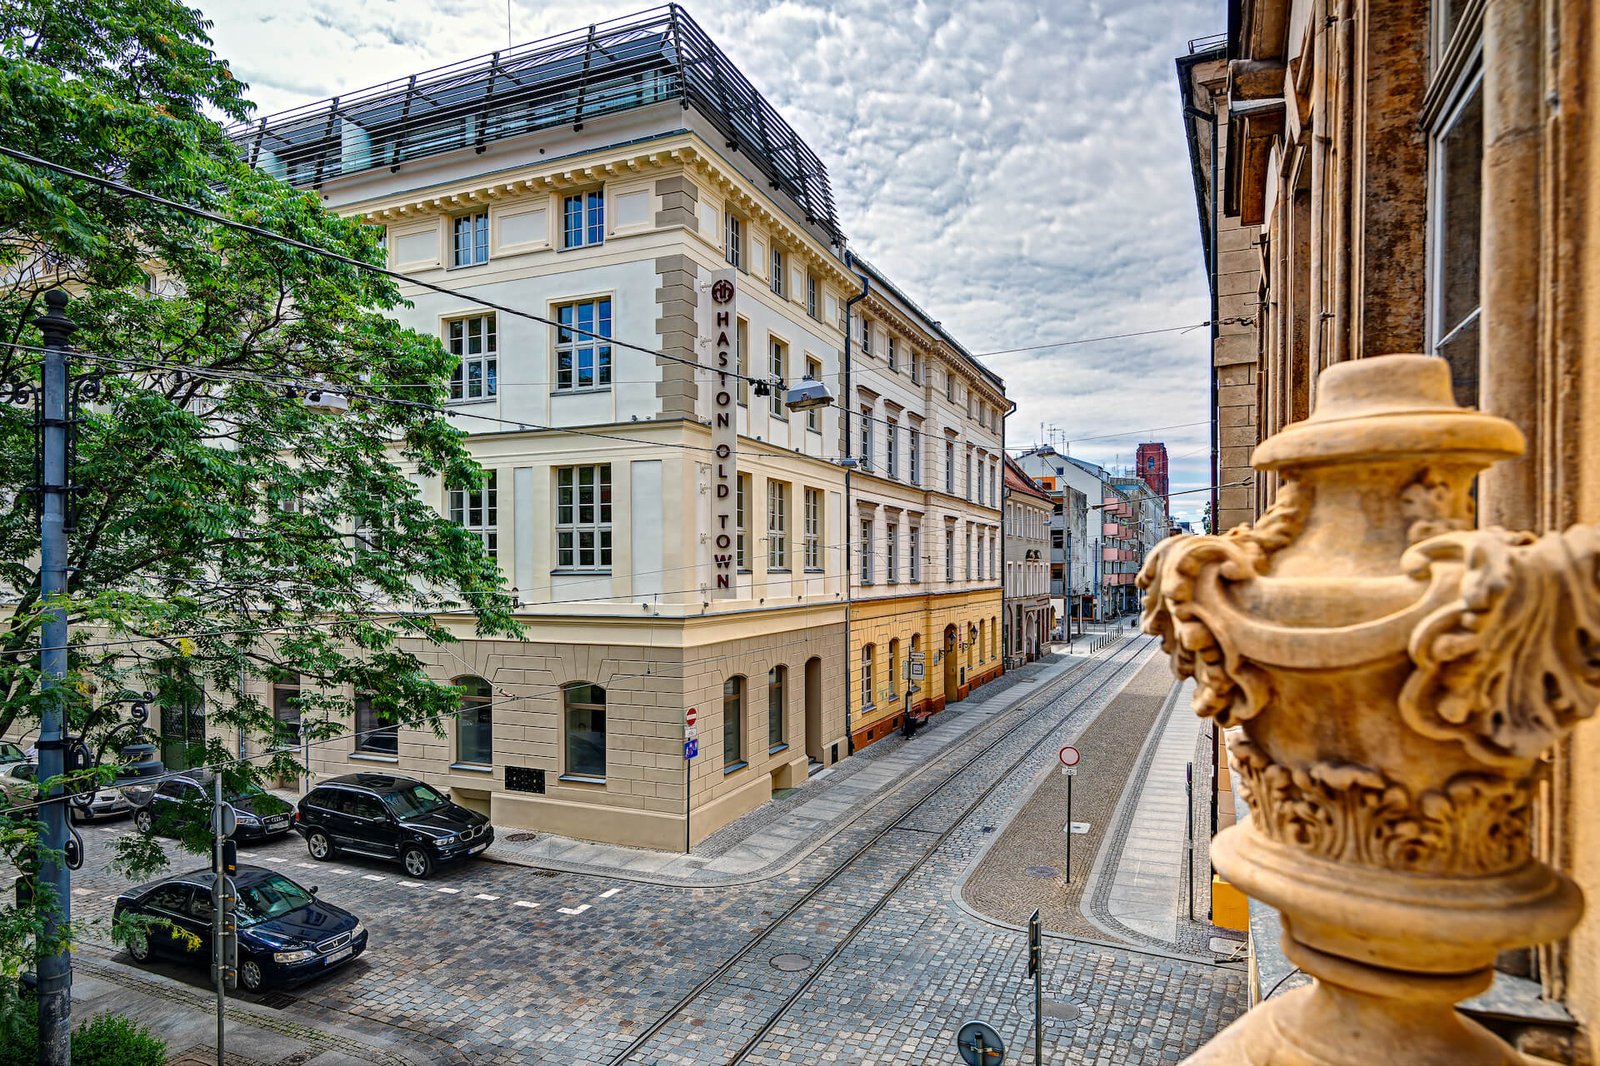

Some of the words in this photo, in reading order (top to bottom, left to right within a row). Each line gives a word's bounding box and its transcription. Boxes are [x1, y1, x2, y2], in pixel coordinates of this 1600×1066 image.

[716, 311, 730, 429] HASTON
[716, 443, 730, 499] OLD
[714, 514, 732, 589] TOWN
